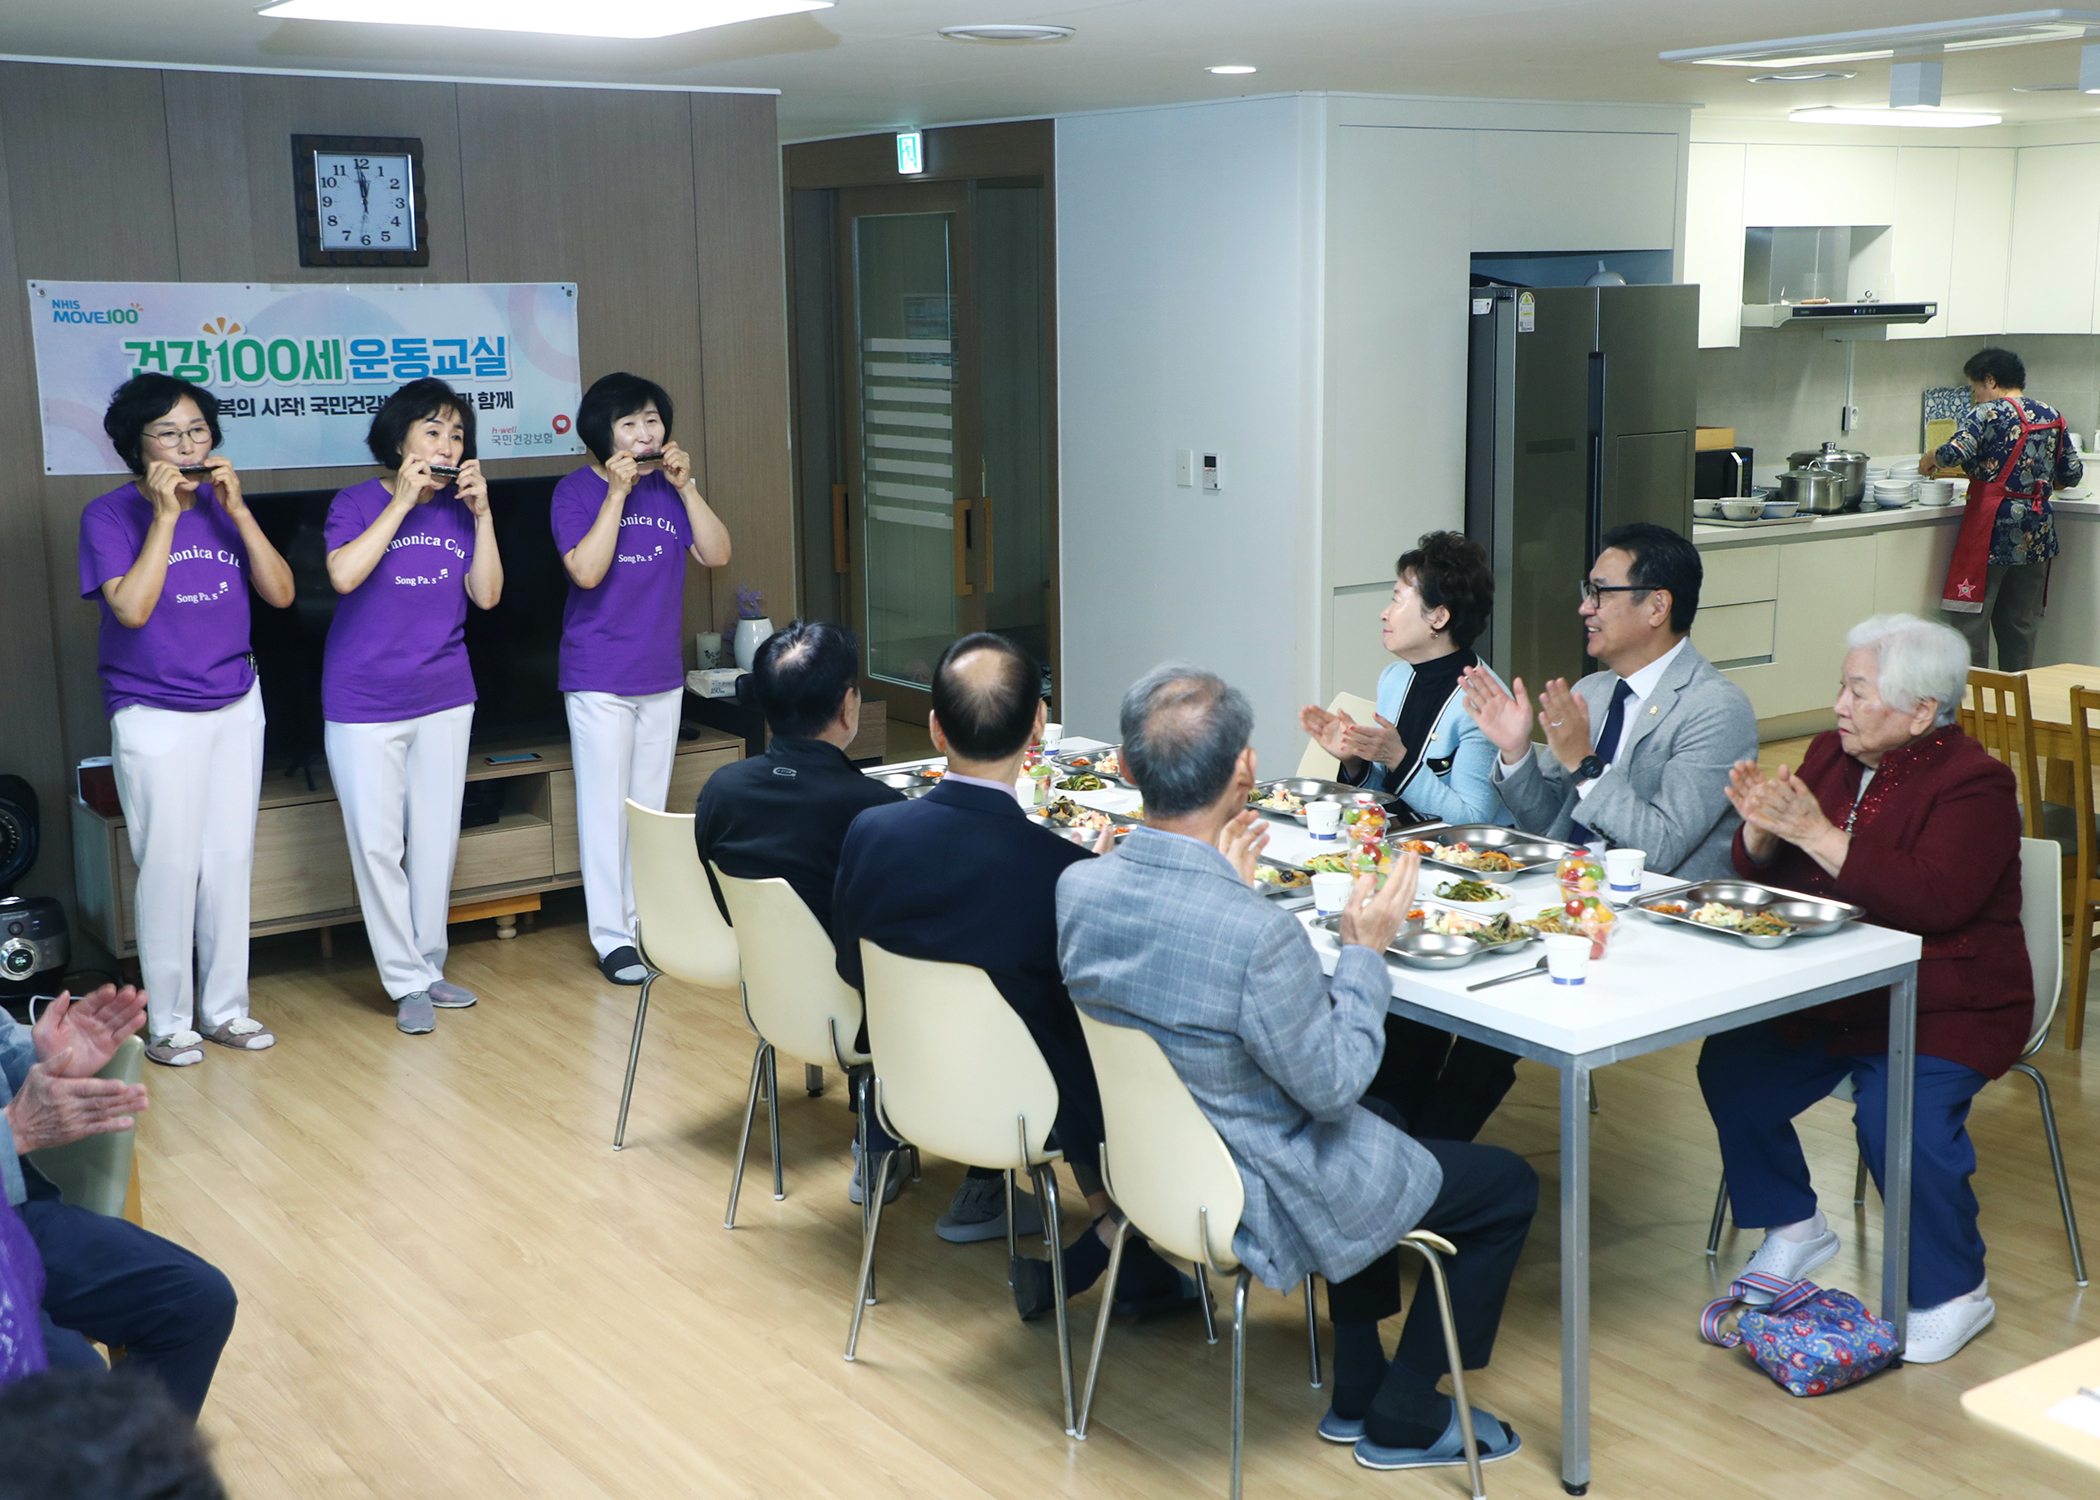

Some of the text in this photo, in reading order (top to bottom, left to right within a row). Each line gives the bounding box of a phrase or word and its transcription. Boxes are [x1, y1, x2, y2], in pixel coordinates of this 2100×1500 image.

[353, 158, 370, 170] 12
[333, 165, 346, 176] 11
[378, 166, 384, 177] 1
[321, 177, 337, 188] 10
[389, 178, 400, 190] 2
[322, 196, 333, 208] 9
[395, 197, 405, 209] 3
[327, 215, 338, 226] 8
[390, 216, 401, 227] 4
[342, 230, 352, 241] 7
[361, 235, 371, 246] 6
[380, 231, 391, 242] 5
[52, 299, 80, 309] NHIS
[53, 309, 139, 324] MOVE100
[124, 336, 507, 382] 건강100세 운동교실
[217, 398, 256, 418] 복의
[261, 397, 306, 416] 시작!
[477, 391, 514, 410] 함께
[491, 432, 553, 446] 국민건강보험
[619, 513, 653, 527] onica
[384, 532, 441, 554] monica
[618, 554, 636, 564] Song
[395, 576, 417, 586] Song
[176, 594, 199, 604] Song
